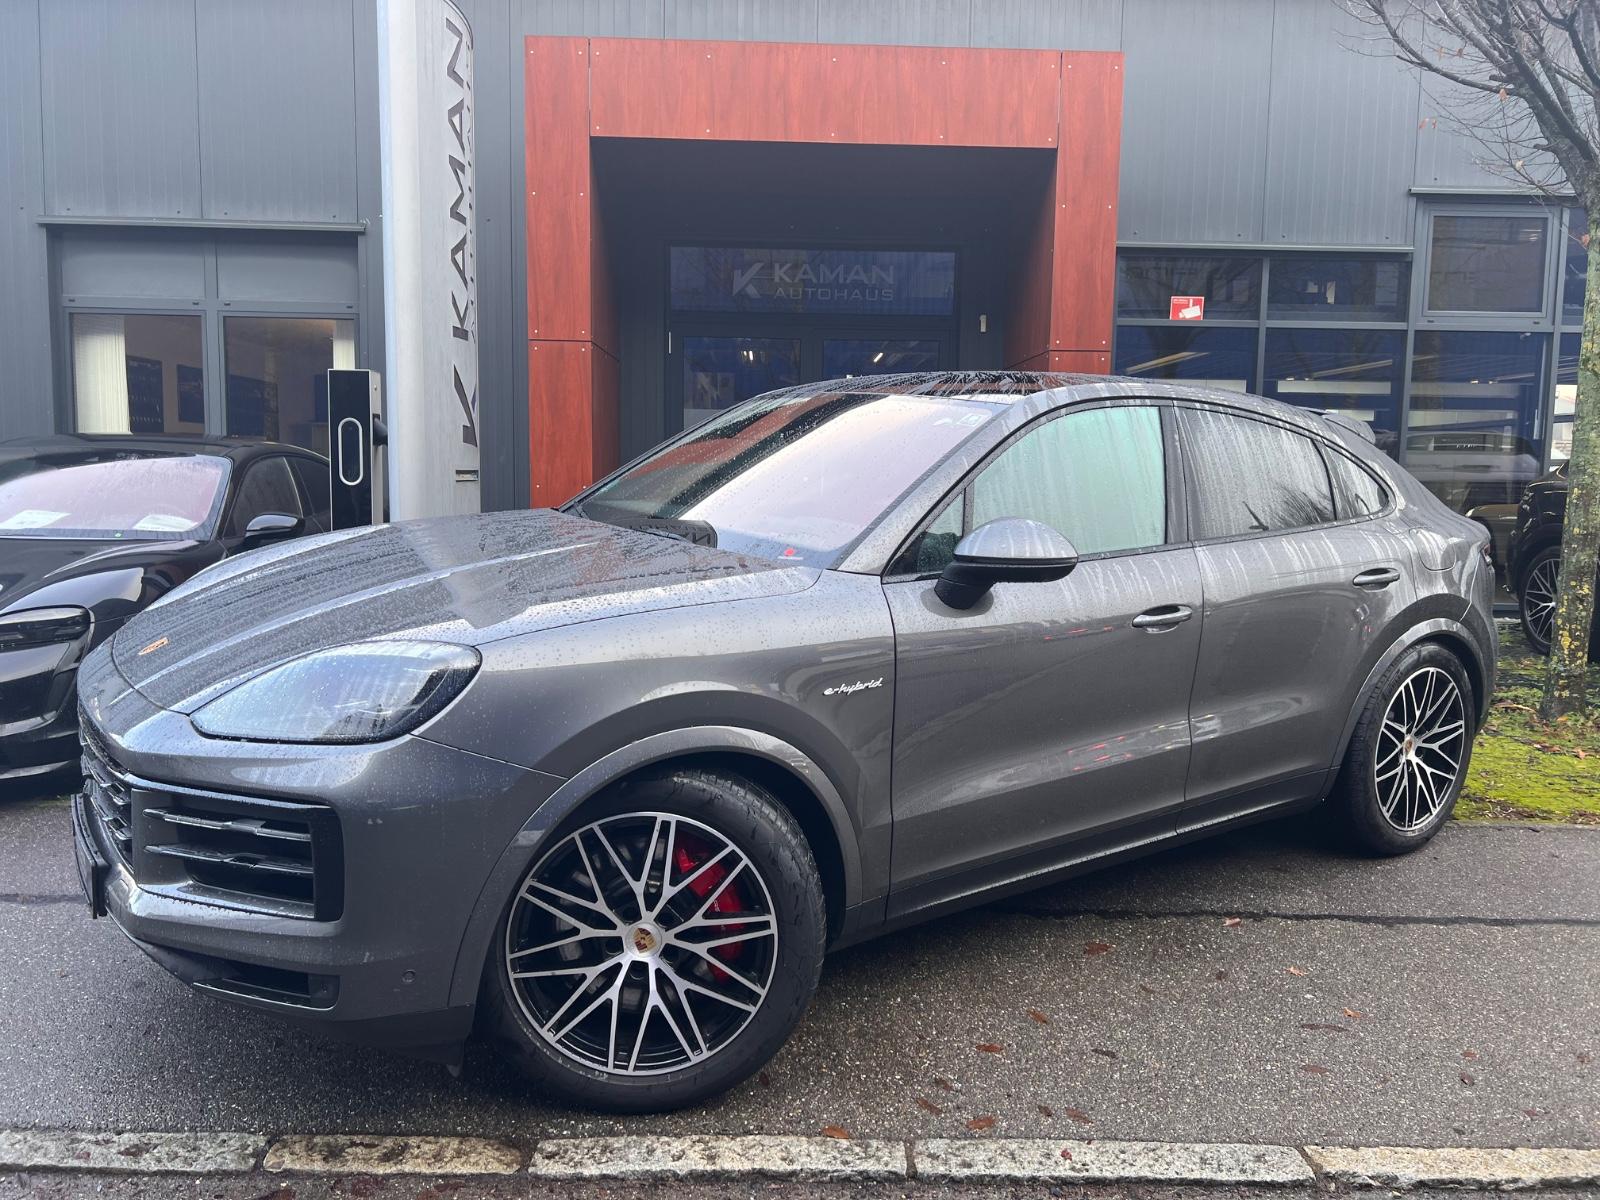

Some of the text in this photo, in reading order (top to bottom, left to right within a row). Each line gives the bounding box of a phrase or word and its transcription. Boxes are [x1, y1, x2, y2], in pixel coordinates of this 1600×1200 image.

[446, 17, 468, 340] KAMAN
[774, 264, 894, 284] KAMAN
[774, 287, 894, 300] AUTOHAUS
[823, 677, 883, 695] e-hybrid
